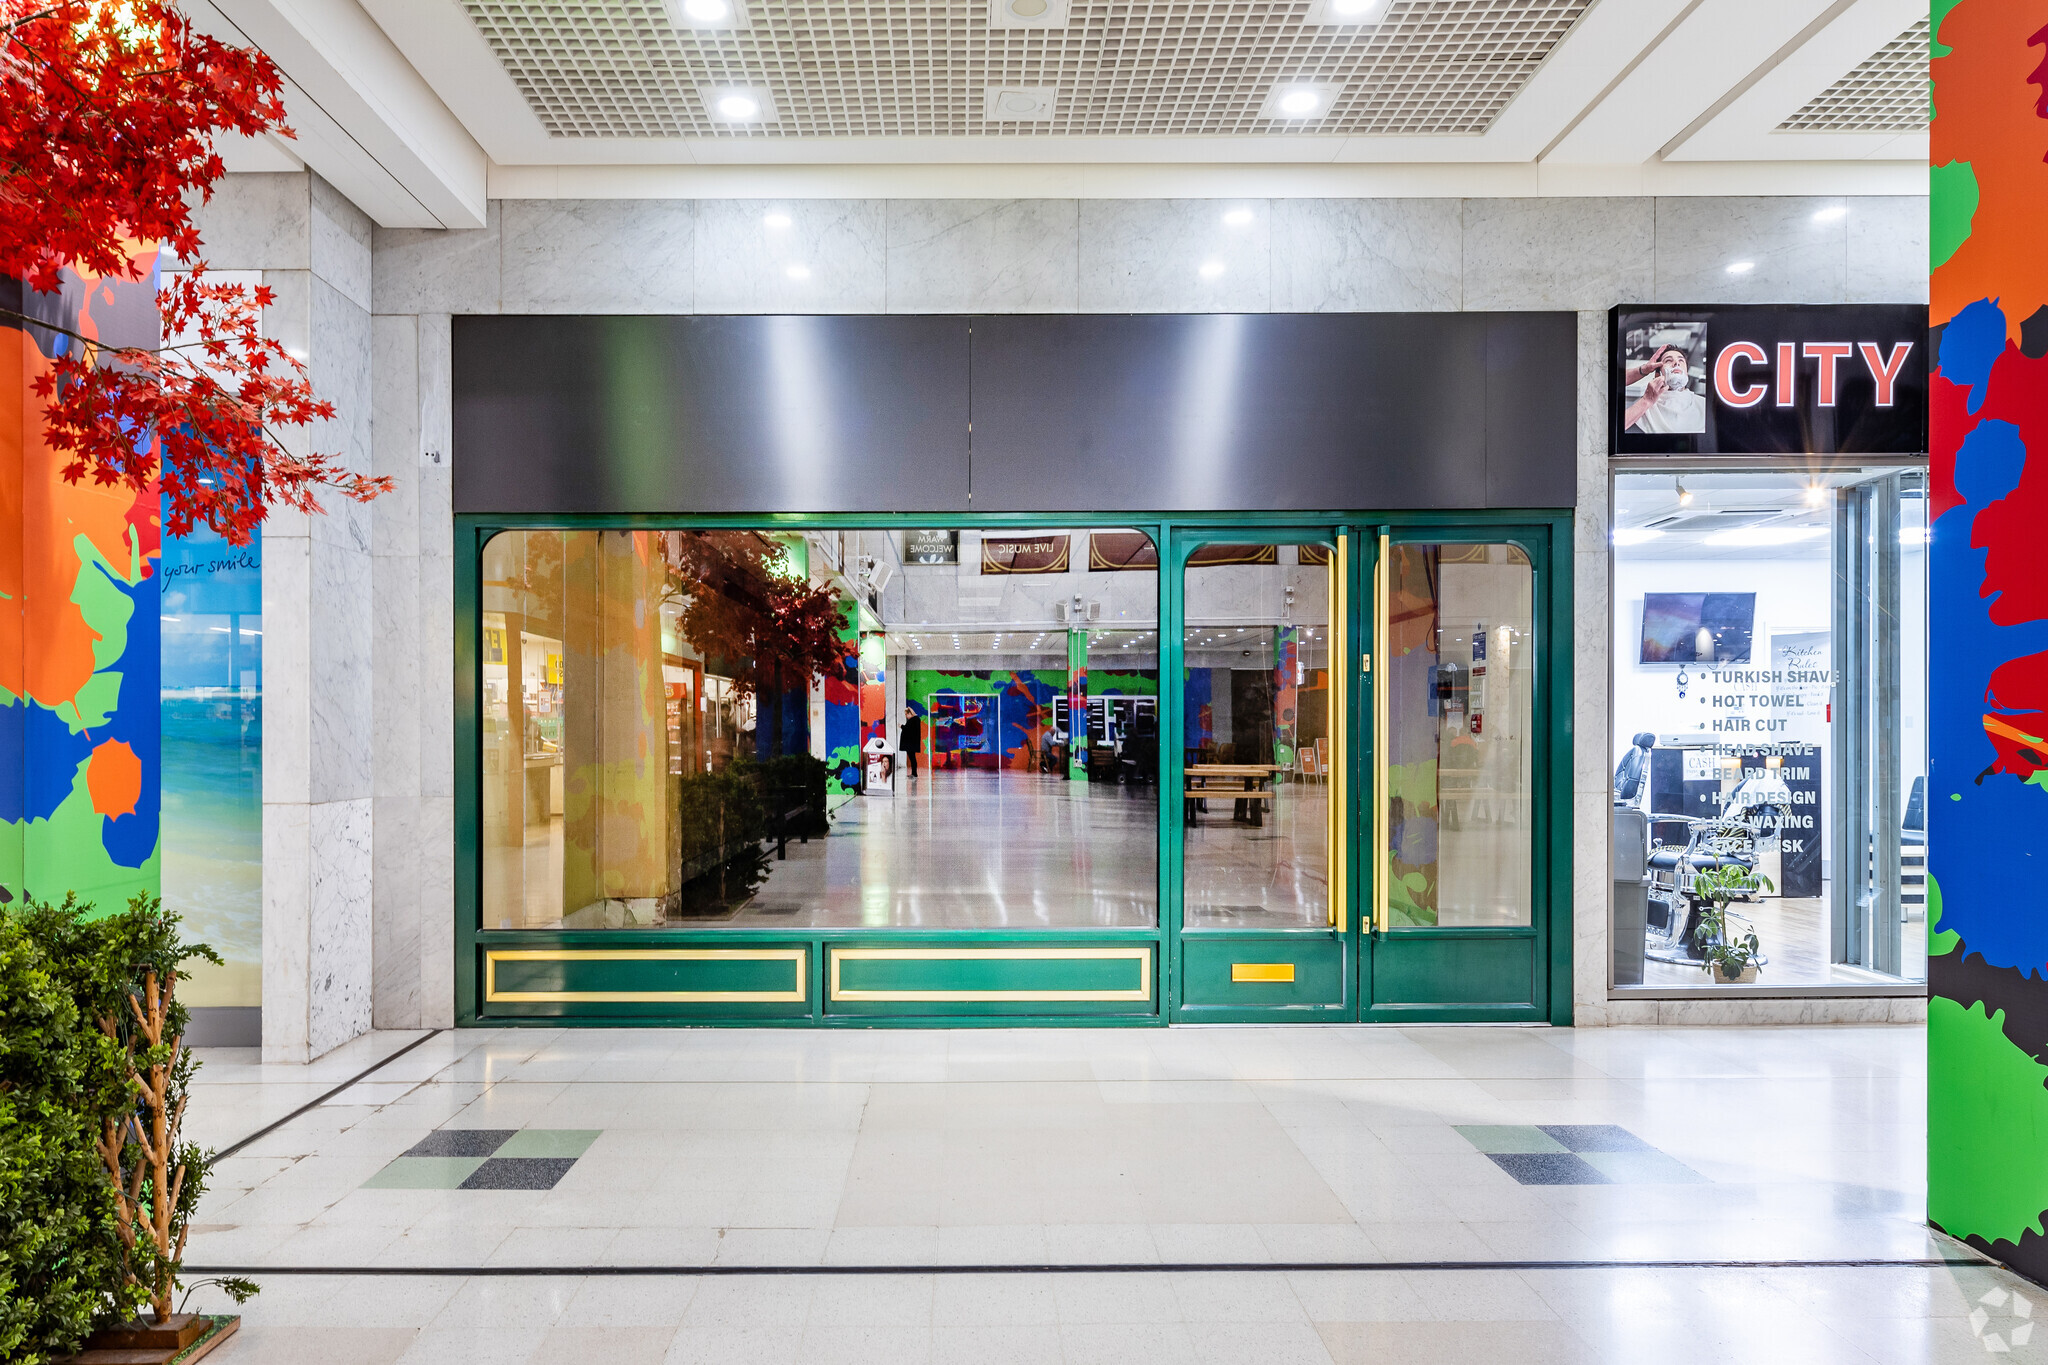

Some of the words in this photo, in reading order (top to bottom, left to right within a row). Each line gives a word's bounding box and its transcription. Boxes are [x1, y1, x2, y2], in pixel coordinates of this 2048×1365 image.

[1713, 341, 1914, 408] CITY
[162, 562, 205, 593] your
[207, 551, 261, 573] smile
[1782, 645, 1822, 657] Kitchen
[1712, 670, 1782, 683] TURKISH
[1787, 670, 1840, 683] SHAVE
[1712, 695, 1745, 707] HOT
[1749, 694, 1804, 707] TOWEL
[1712, 719, 1751, 731] HAIR
[1755, 719, 1788, 731] CUT
[1712, 743, 1757, 756] HEAD
[1760, 743, 1814, 756] SHAVE
[1712, 767, 1766, 780] BEARD
[1770, 766, 1810, 780] TRIM
[1712, 791, 1751, 805] HAIR
[1755, 791, 1816, 804] DESIGN
[1712, 815, 1745, 829] HOT
[1749, 815, 1814, 828] WAXING
[1712, 839, 1753, 853] FACE
